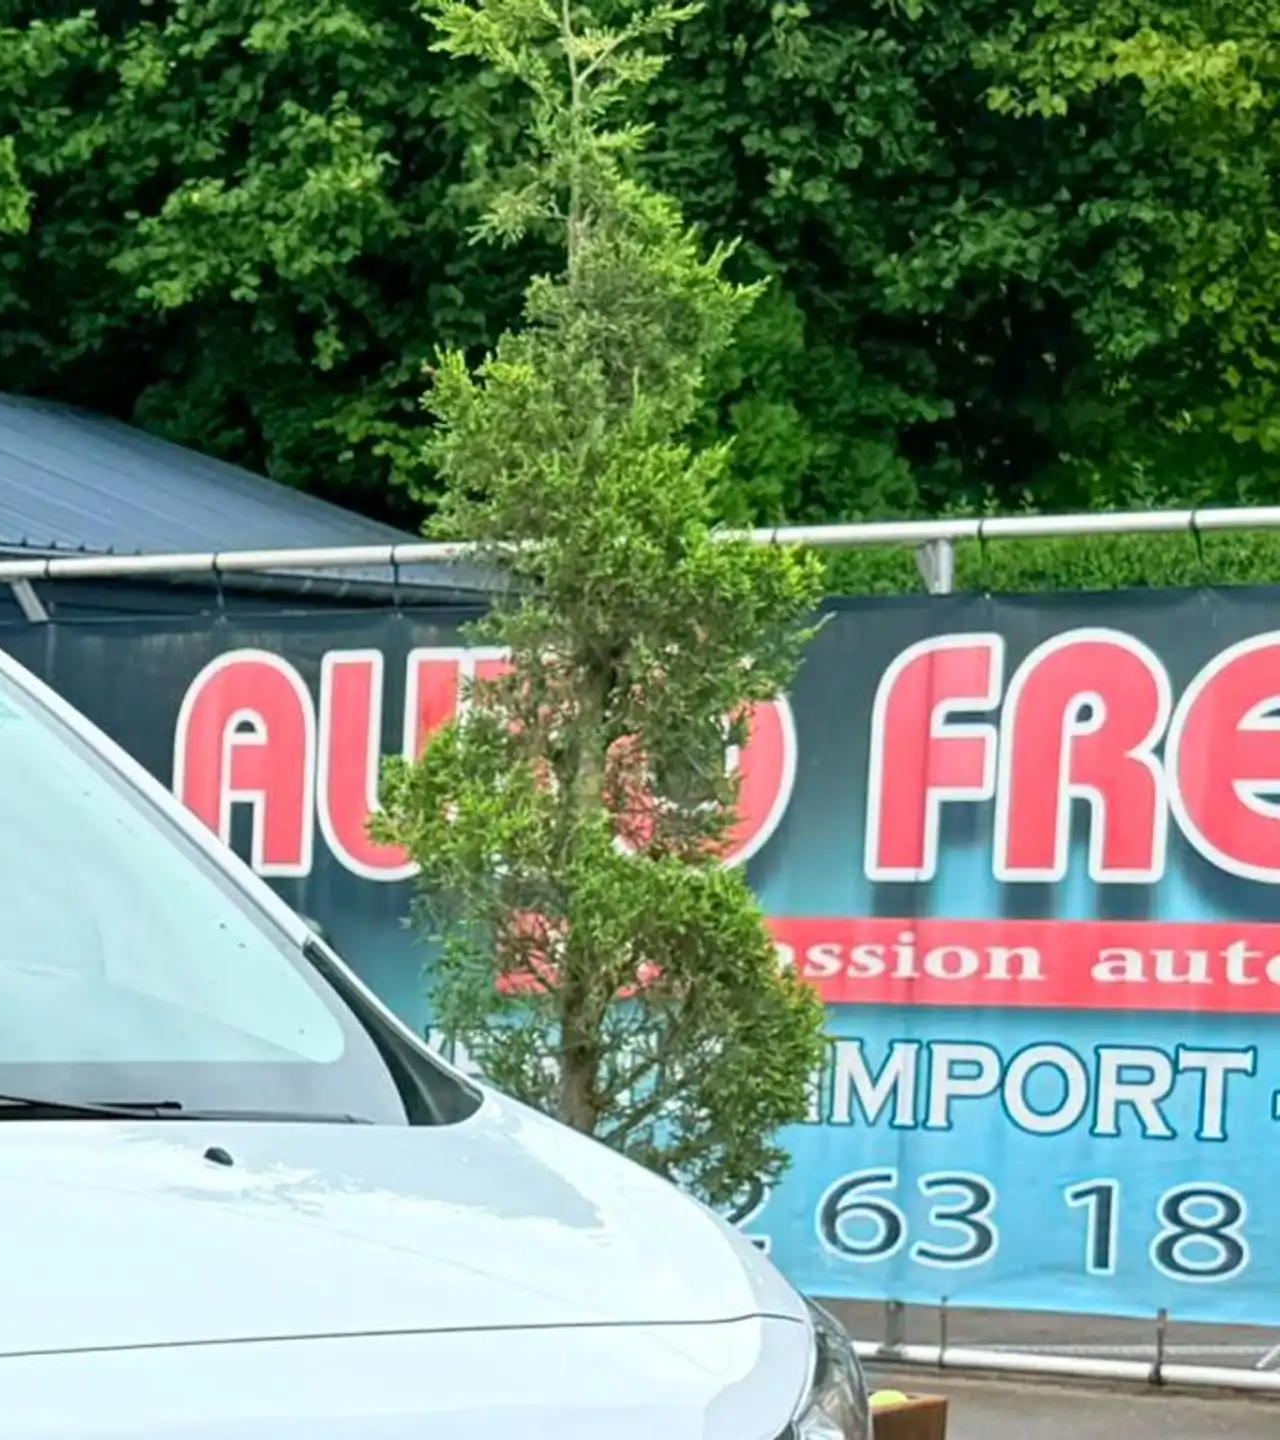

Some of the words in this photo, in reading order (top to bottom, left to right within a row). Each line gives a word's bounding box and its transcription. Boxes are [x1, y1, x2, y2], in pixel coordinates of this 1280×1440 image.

[770, 931, 1046, 982] ssion
[1091, 940, 1280, 985] aut
[816, 1166, 998, 1270] 63
[1064, 1177, 1250, 1284] 18
